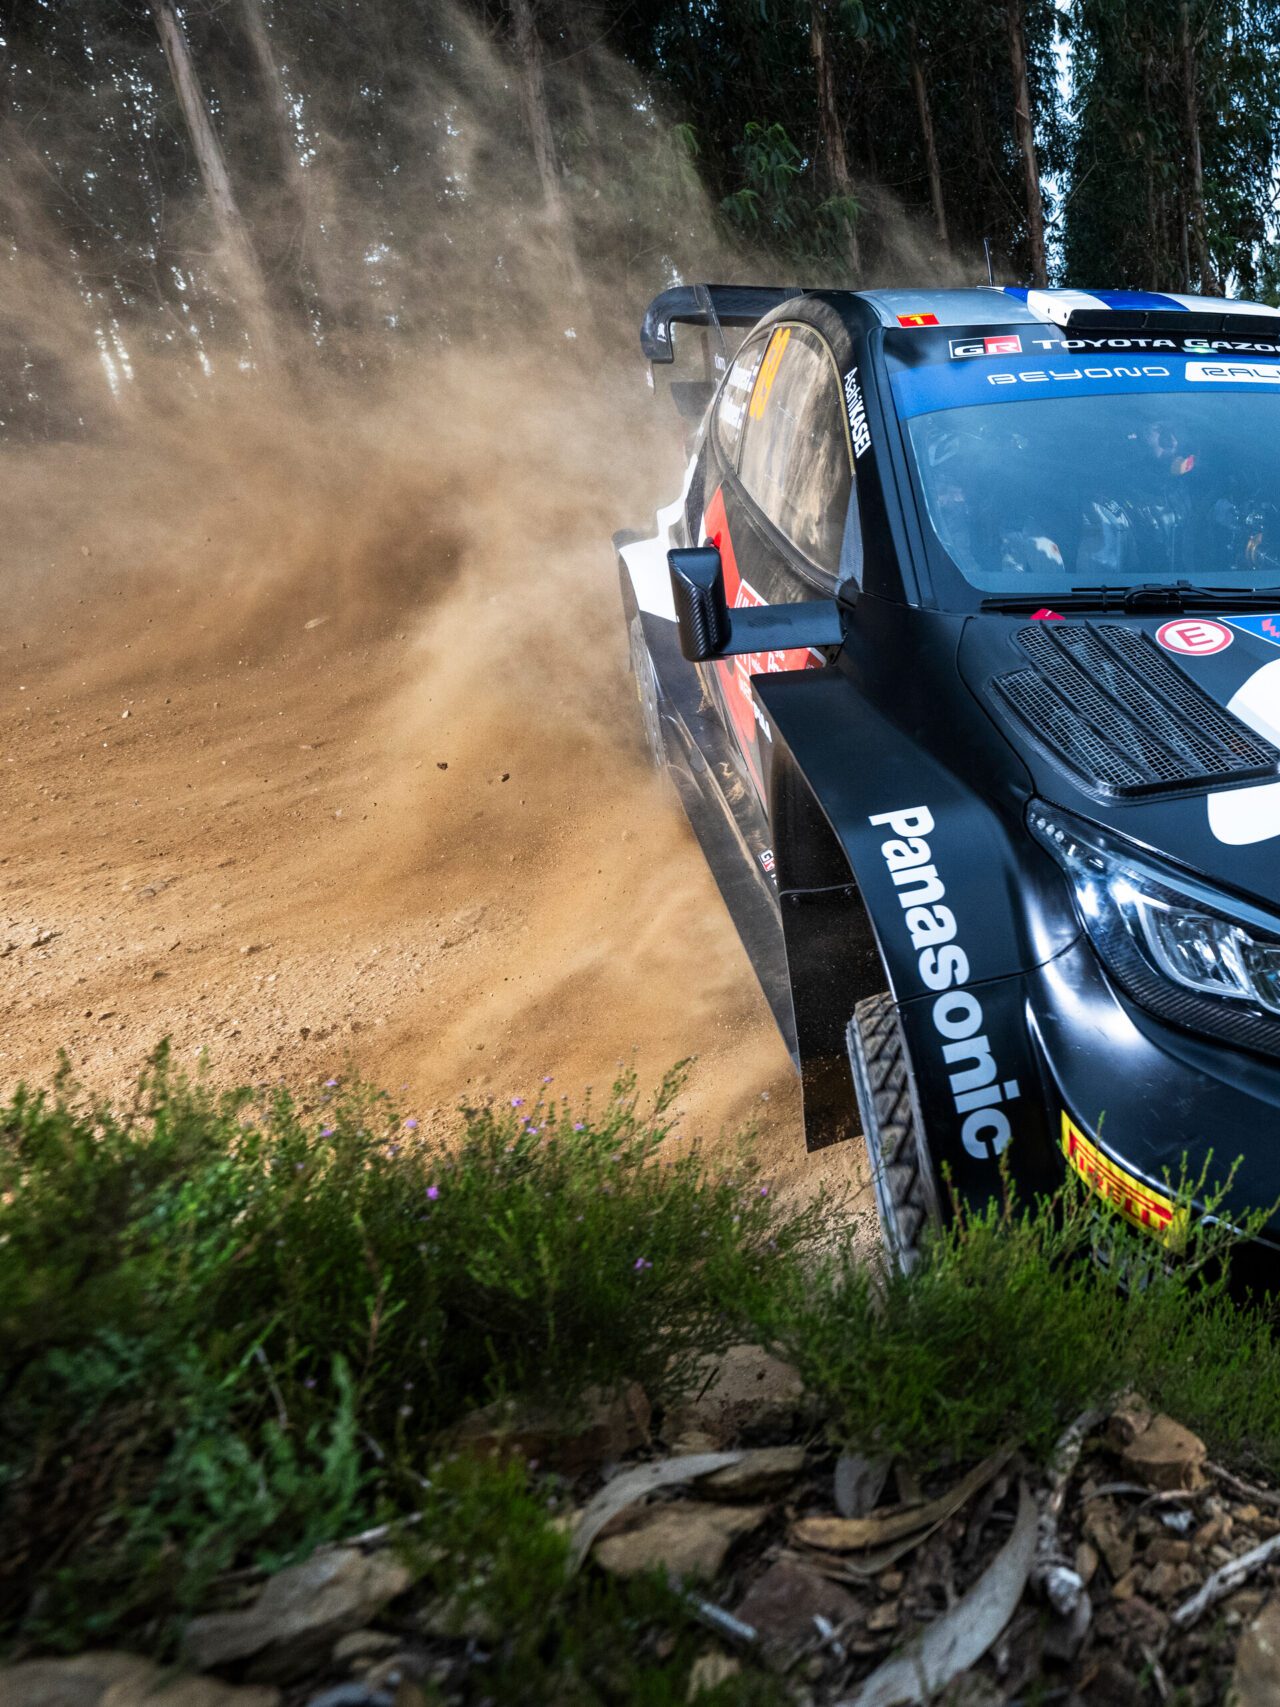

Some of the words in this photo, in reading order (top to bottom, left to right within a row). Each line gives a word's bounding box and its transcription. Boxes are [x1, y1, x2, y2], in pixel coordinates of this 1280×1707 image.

[1032, 338, 1176, 350] TOYOTA
[987, 366, 1170, 385] BEYOND
[1176, 626, 1214, 647] E
[869, 805, 1021, 1159] Panasonic
